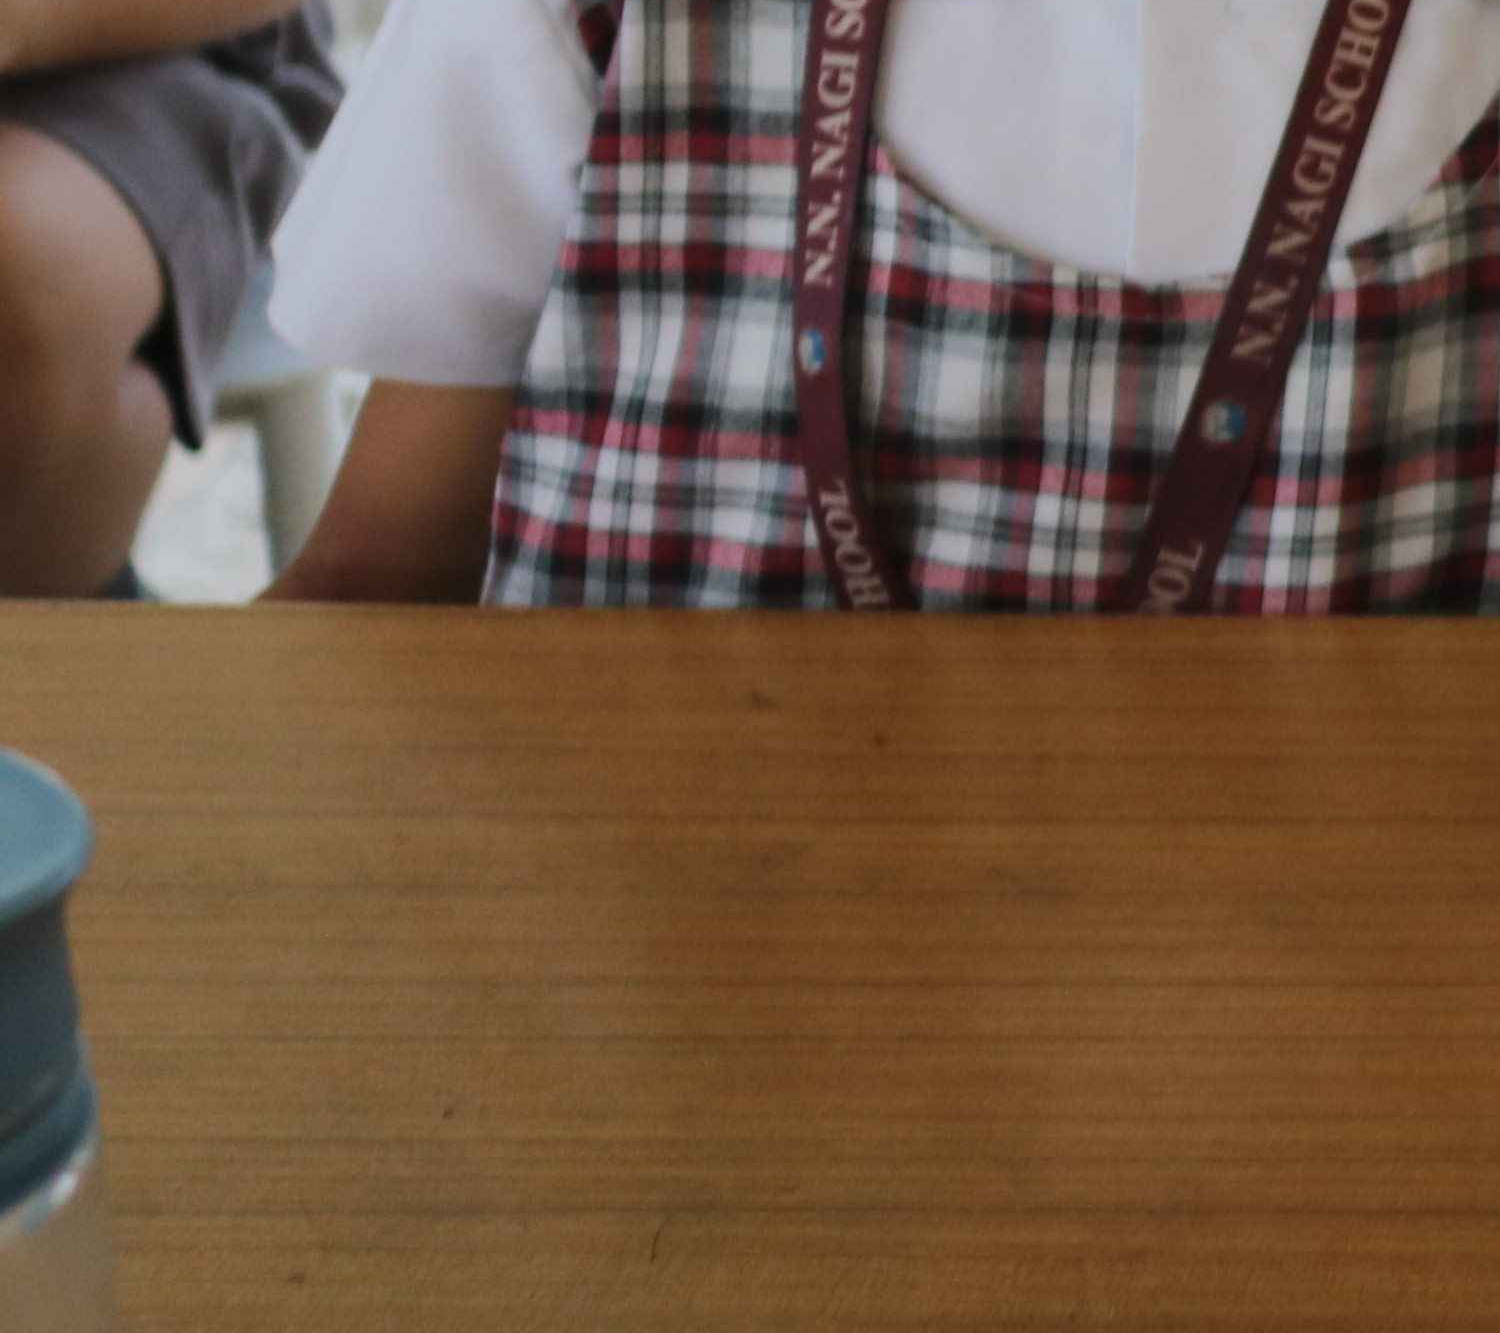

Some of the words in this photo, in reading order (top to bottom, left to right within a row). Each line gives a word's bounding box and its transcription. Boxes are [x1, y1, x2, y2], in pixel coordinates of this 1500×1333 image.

[809, 49, 860, 180] NAGI
[803, 188, 842, 288] N.N.
[1230, 275, 1298, 367] N.N.
[1265, 133, 1345, 265] NAGI
